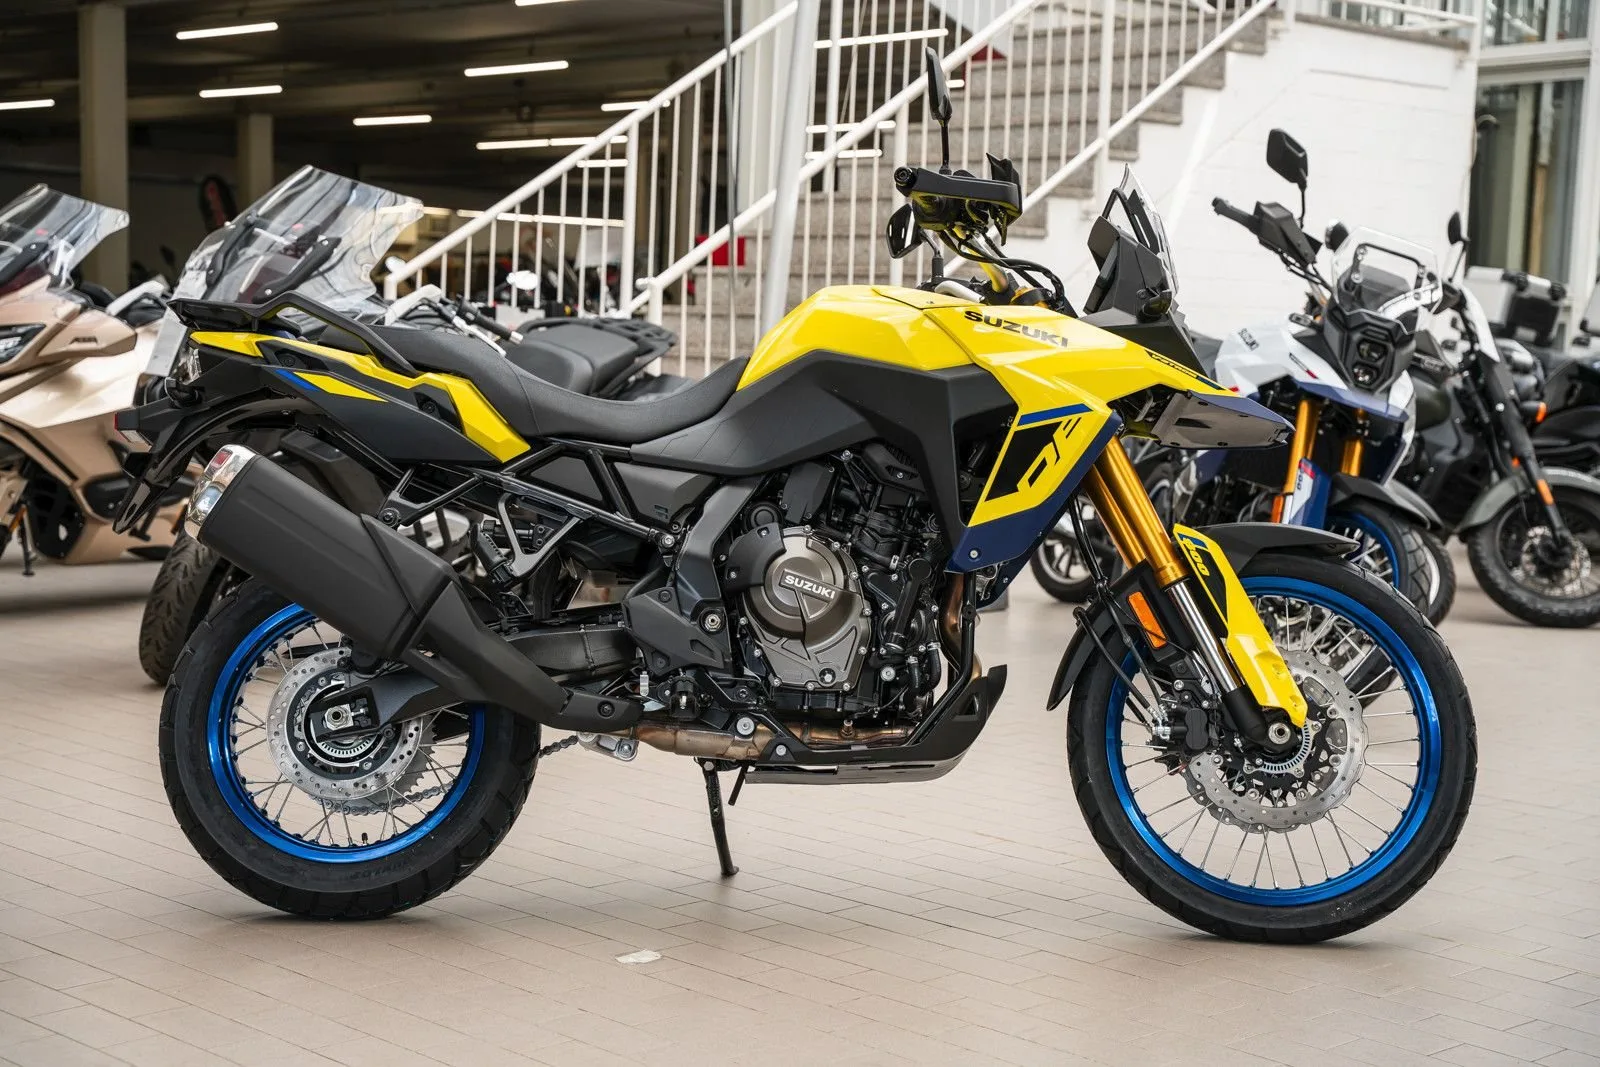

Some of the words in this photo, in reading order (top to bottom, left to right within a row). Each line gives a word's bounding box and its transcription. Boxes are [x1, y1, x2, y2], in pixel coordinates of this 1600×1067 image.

[964, 310, 1068, 348] SUZUKI
[1182, 537, 1210, 576] 800
[785, 574, 836, 600] SUZUKI
